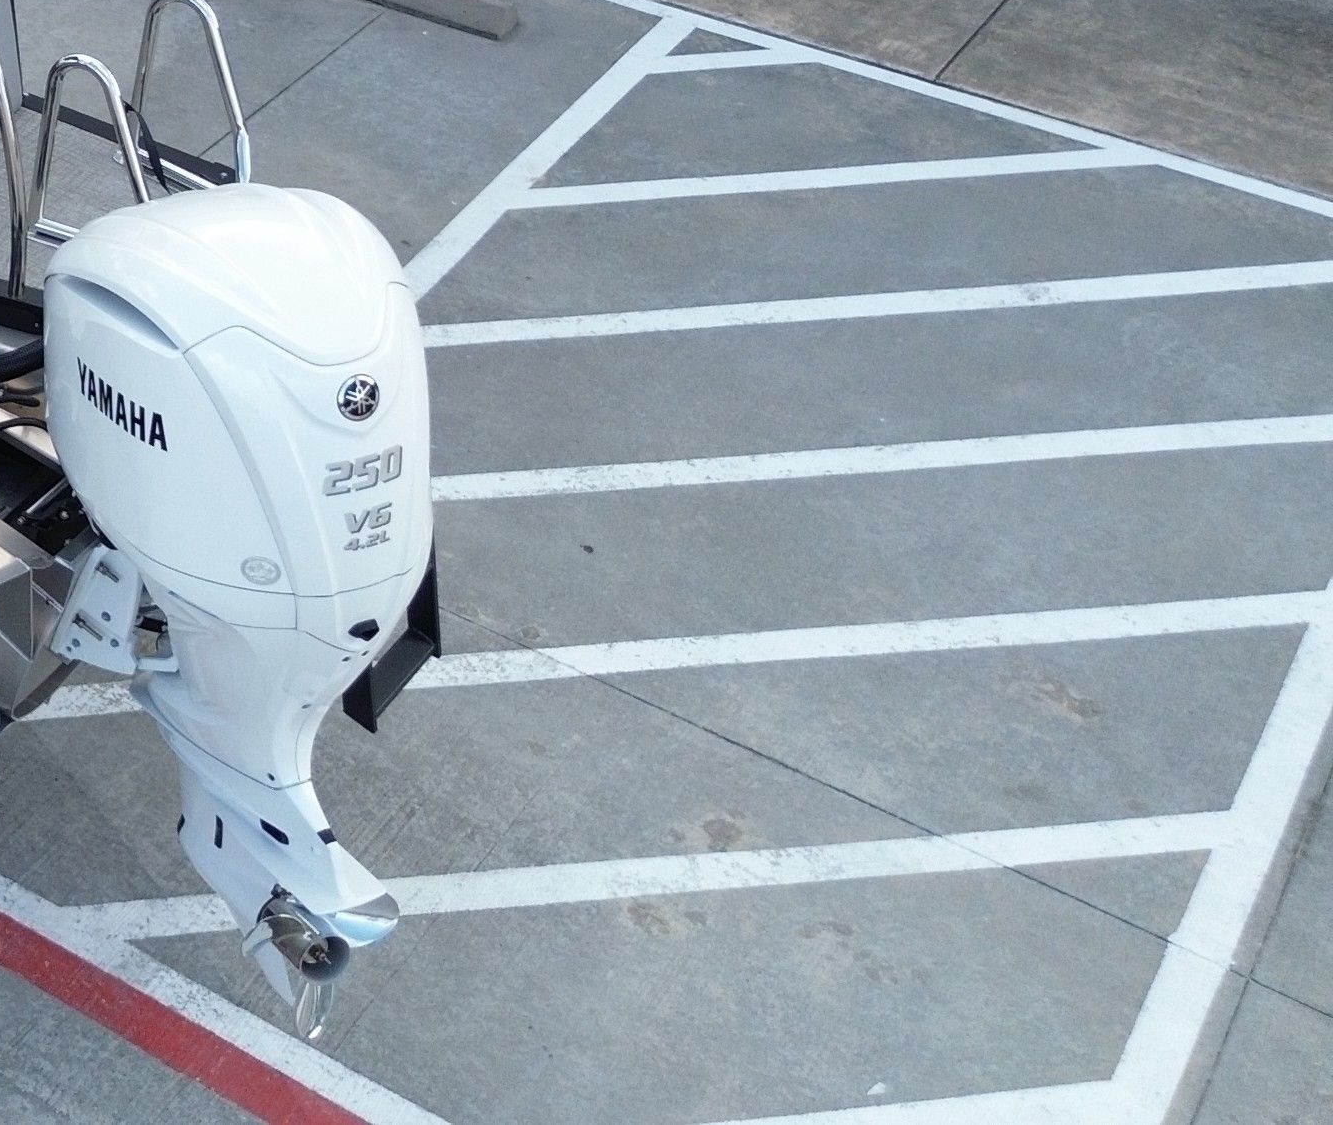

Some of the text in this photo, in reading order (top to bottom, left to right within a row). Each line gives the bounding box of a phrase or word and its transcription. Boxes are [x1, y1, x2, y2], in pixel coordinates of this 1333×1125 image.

[77, 356, 168, 452] YAMAHA
[322, 444, 403, 497] 250
[343, 501, 393, 534] V6
[343, 530, 391, 551] 4.2L
